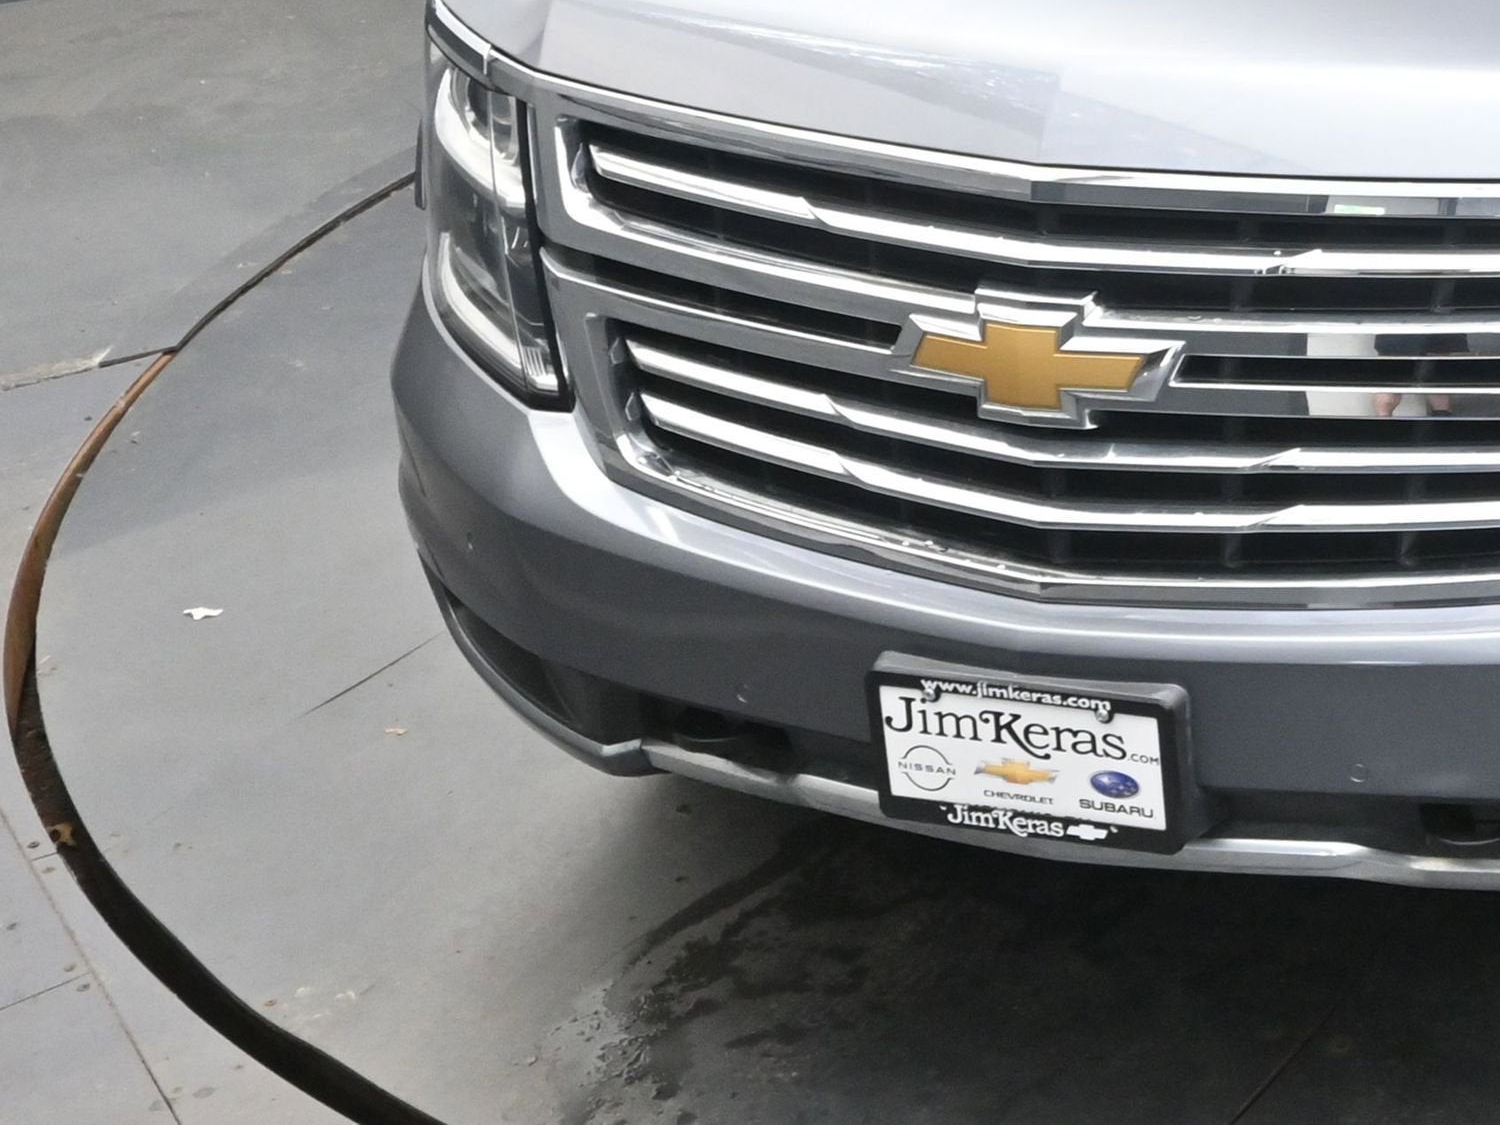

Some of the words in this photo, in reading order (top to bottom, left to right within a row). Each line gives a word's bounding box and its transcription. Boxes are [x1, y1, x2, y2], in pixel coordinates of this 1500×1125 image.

[920, 679, 1111, 711] www.jimkeras.com
[897, 761, 957, 776] NISSAN
[983, 789, 1054, 805] CHEVROLET
[1079, 798, 1154, 819] SUBARU
